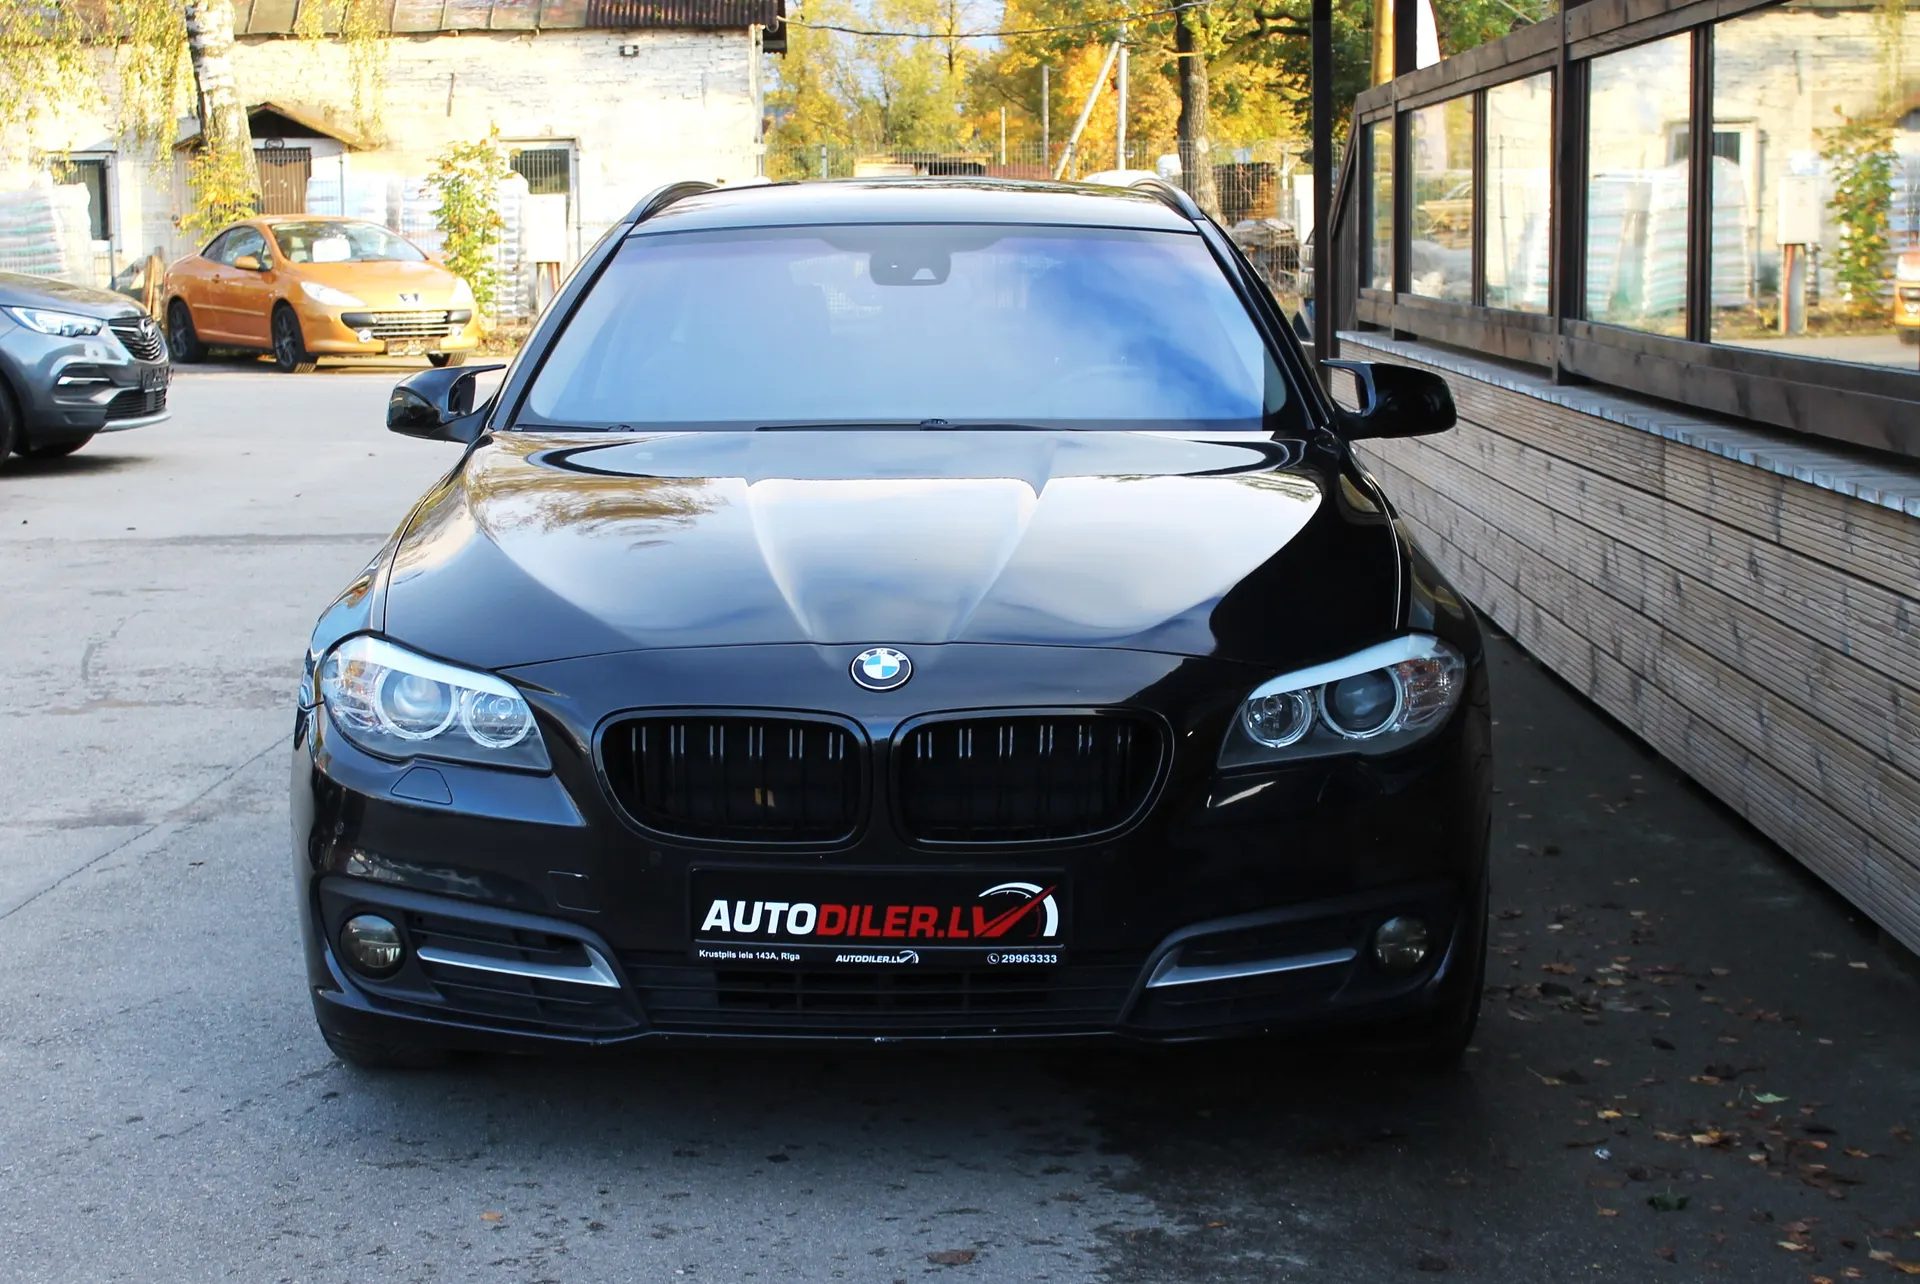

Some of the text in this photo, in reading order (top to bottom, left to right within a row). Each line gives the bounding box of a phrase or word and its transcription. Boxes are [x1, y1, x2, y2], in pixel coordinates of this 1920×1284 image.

[701, 897, 1020, 937] AUTODILER.LV
[699, 949, 736, 960] Krustpils
[738, 951, 753, 959] iela
[755, 951, 779, 960] 143A,
[1001, 954, 1058, 964] 29963333
